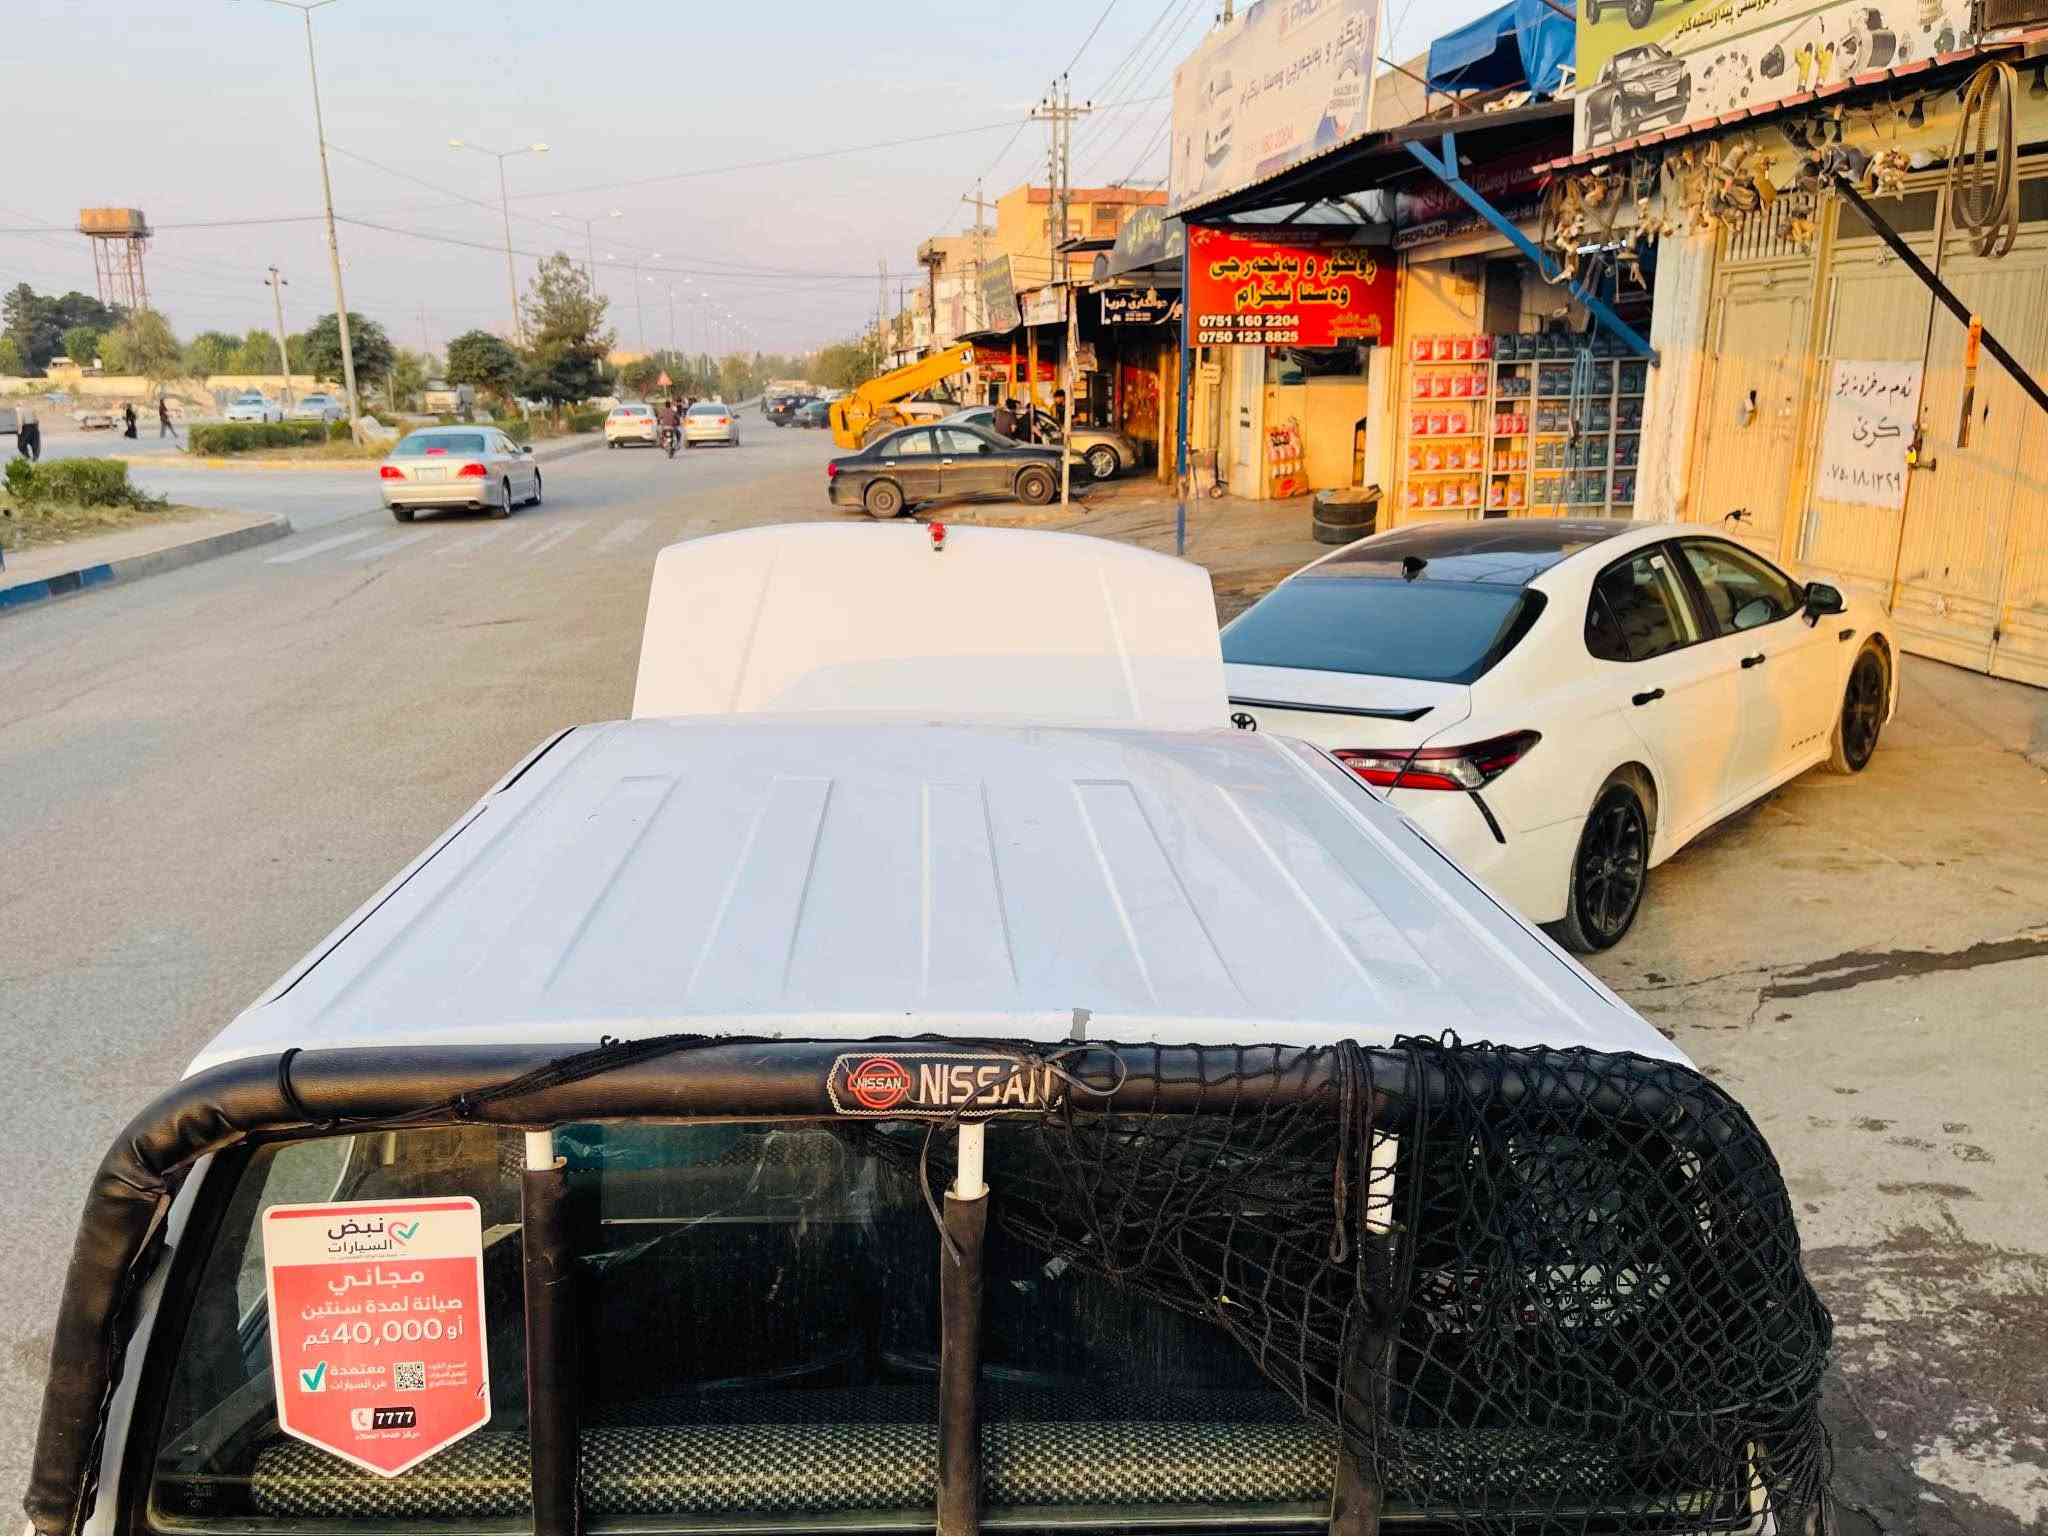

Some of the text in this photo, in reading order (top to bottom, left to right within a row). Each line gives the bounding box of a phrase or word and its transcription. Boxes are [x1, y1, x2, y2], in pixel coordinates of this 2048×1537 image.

[1304, 257, 1316, 277] و
[1199, 315, 1299, 327] 0751 160 2204
[1199, 331, 1299, 343] 0750 123 8825
[857, 1077, 901, 1090] NISSAN
[328, 1217, 384, 1240] نبض
[328, 1239, 393, 1254] السيارات
[328, 1265, 425, 1295] مجاني
[302, 1296, 463, 1320] صيانة لمدة سنتين
[303, 1315, 464, 1353] أو 40,000 كم
[375, 1411, 414, 1425] 7777
